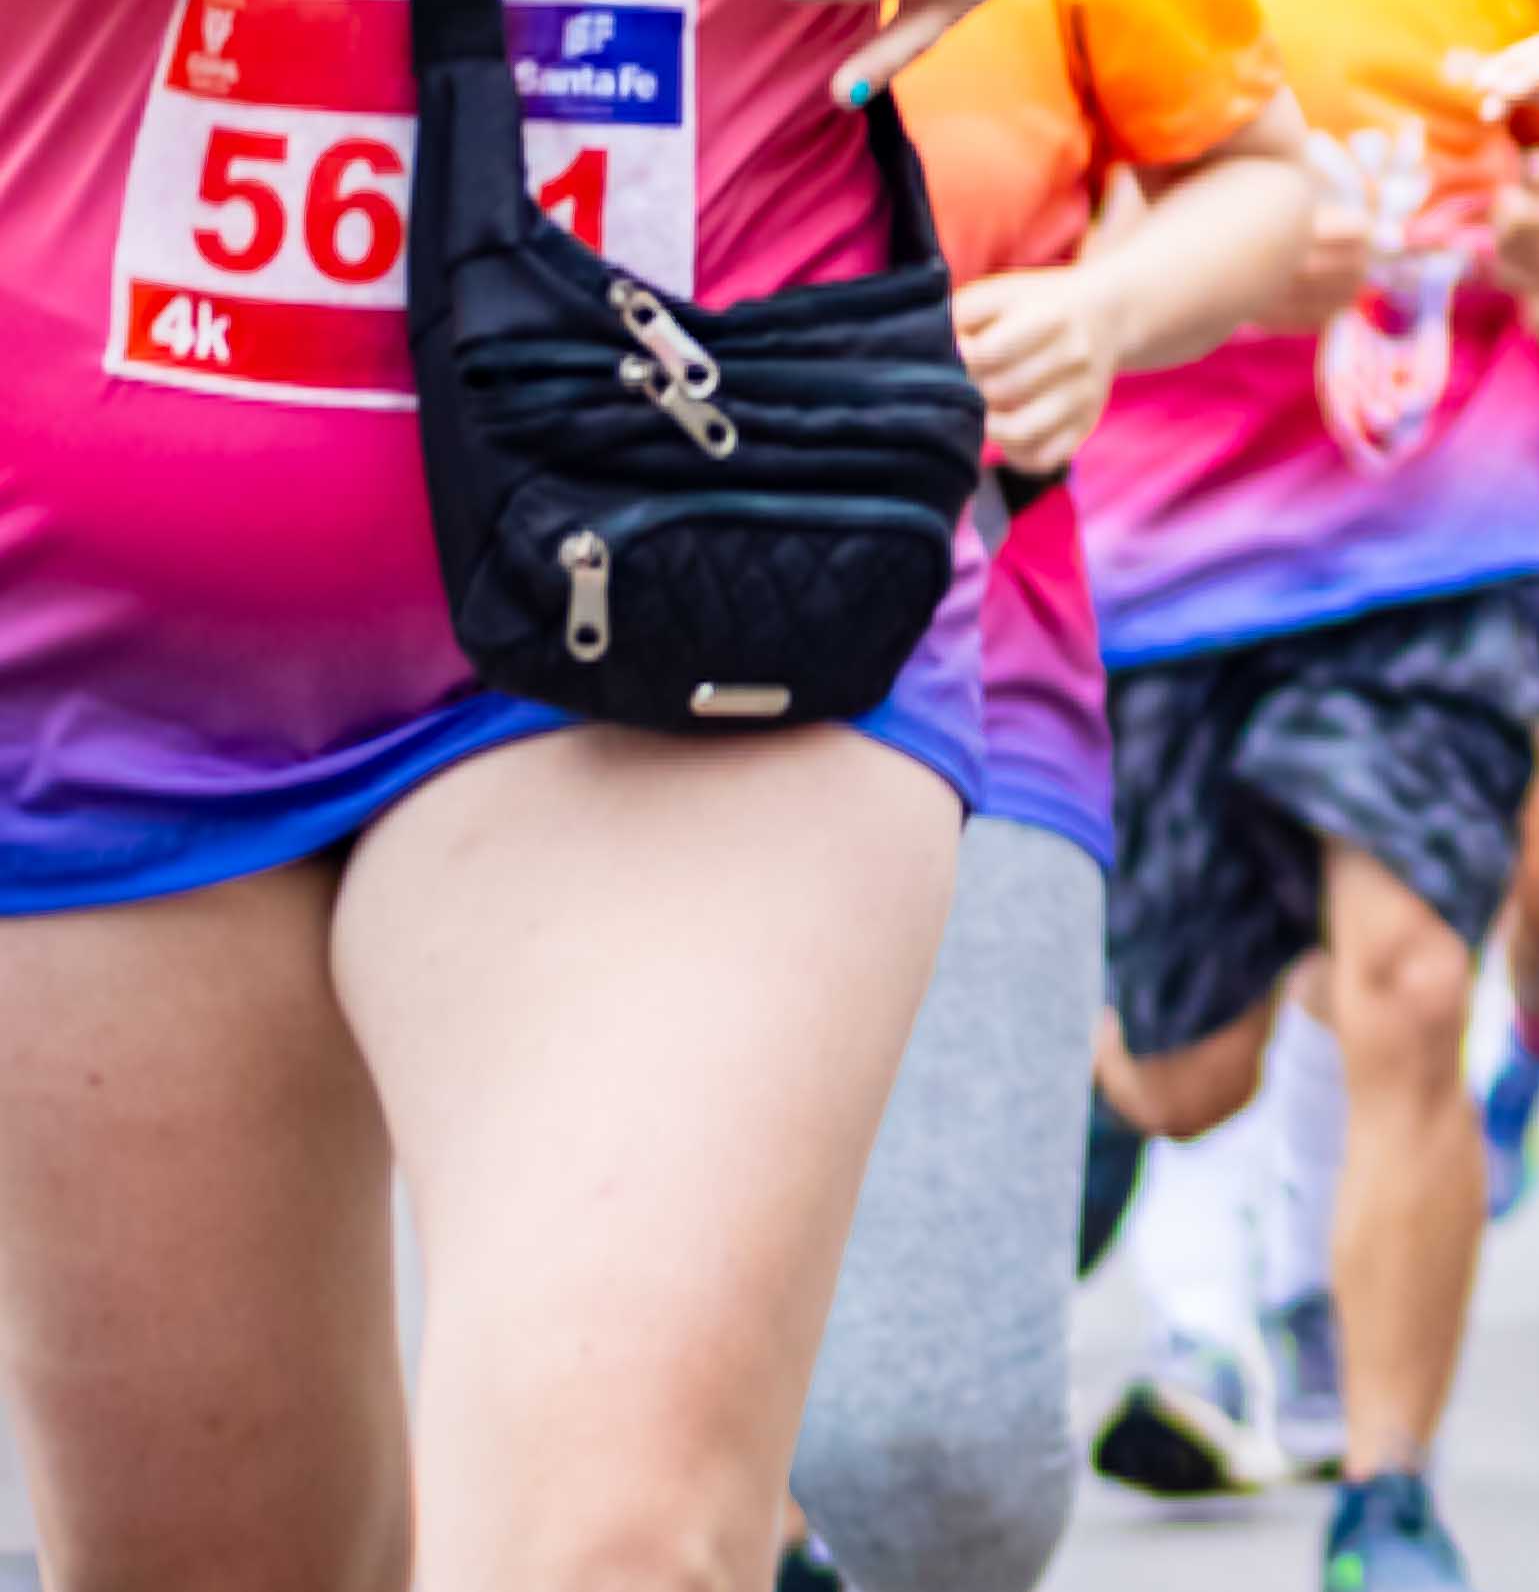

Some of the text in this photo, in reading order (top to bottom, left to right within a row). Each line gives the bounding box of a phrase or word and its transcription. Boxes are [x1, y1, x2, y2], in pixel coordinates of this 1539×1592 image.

[516, 61, 659, 102] Santa Fe
[192, 125, 609, 285] 561
[149, 295, 231, 363] 4k
